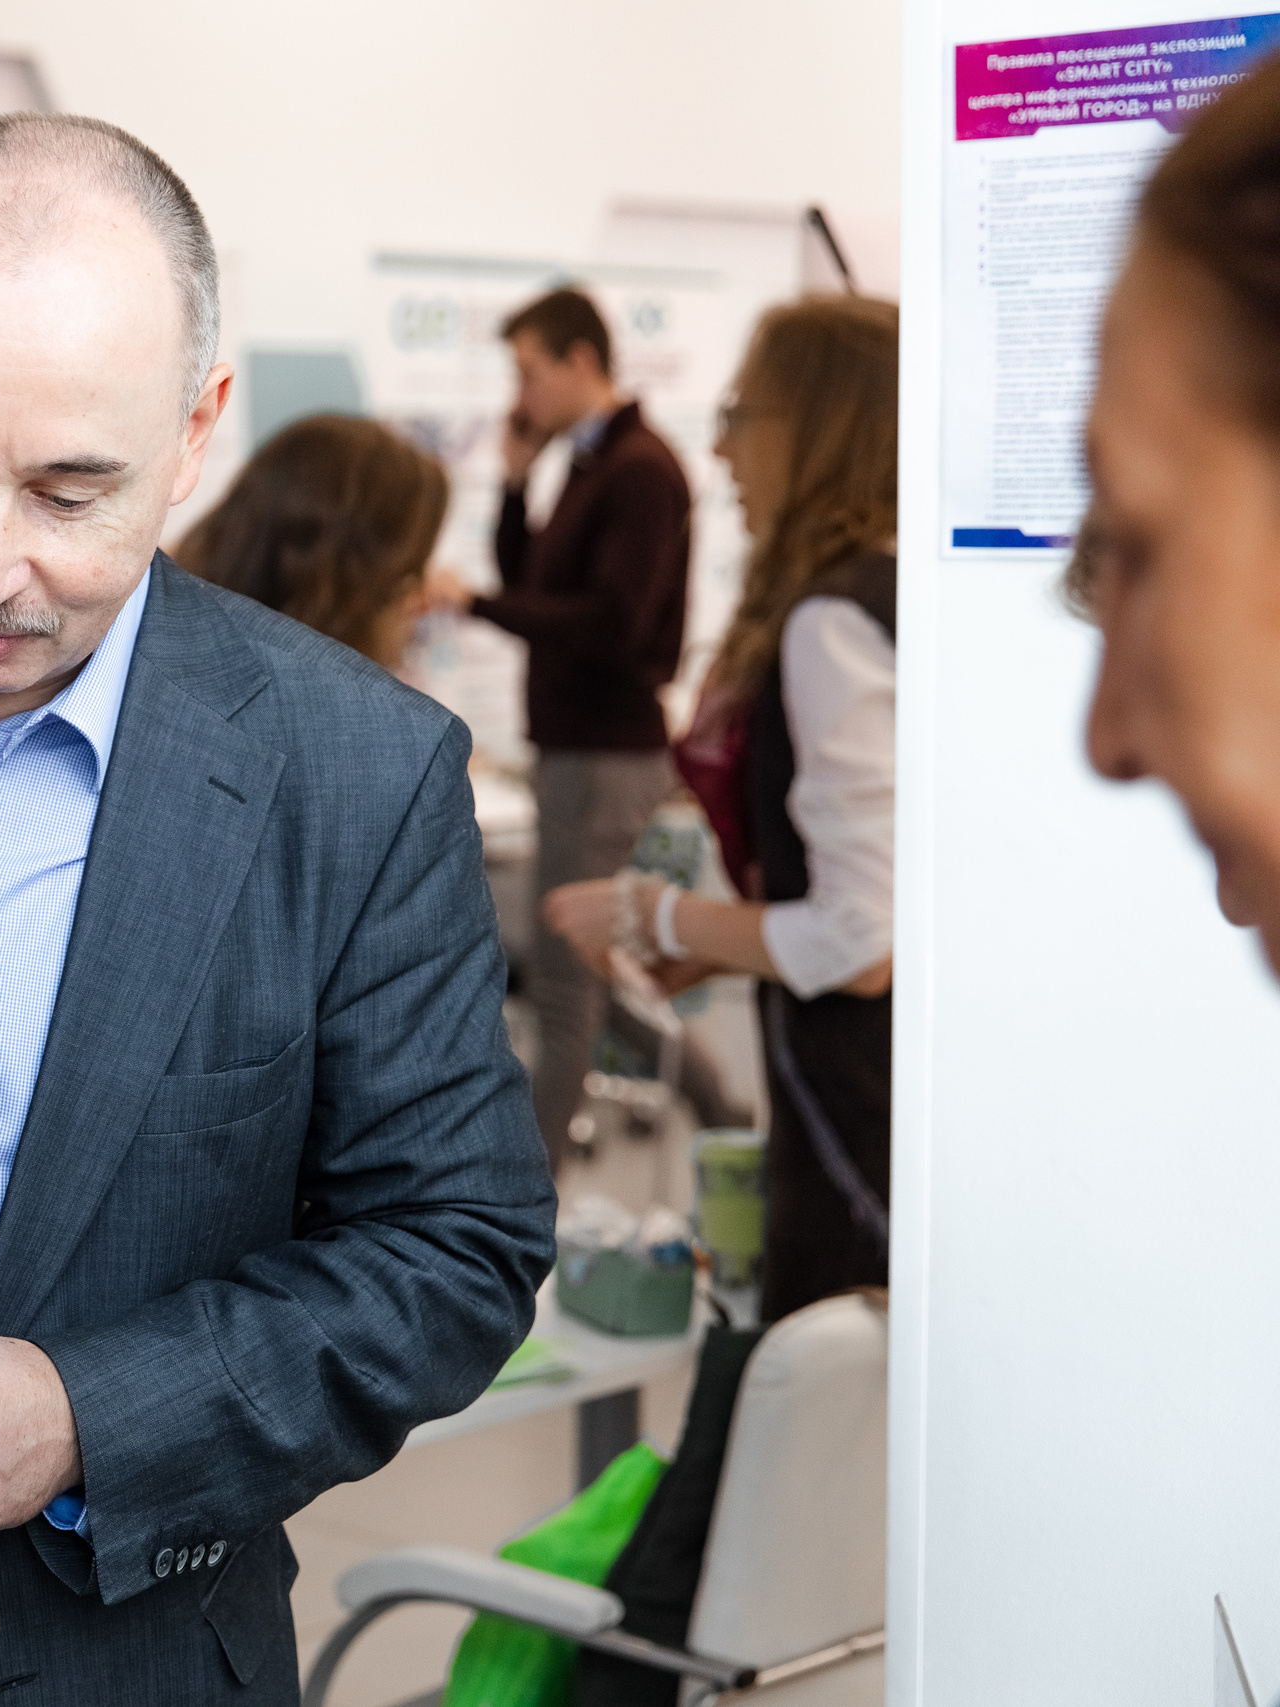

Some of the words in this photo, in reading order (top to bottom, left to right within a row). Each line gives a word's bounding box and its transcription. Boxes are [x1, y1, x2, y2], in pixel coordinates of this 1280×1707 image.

[987, 54, 1055, 72] Правила
[1056, 43, 1147, 65] посещения
[1150, 34, 1246, 56] экспозиции
[1056, 61, 1121, 82] «SMART
[1124, 58, 1173, 77] CITY»
[968, 92, 1024, 111] центра
[1025, 80, 1168, 105] информационных
[1172, 73, 1250, 92] технолог
[1008, 101, 1079, 124] «УМНЫЙ
[1082, 98, 1149, 119] ГОРОД»
[1153, 99, 1173, 112] на
